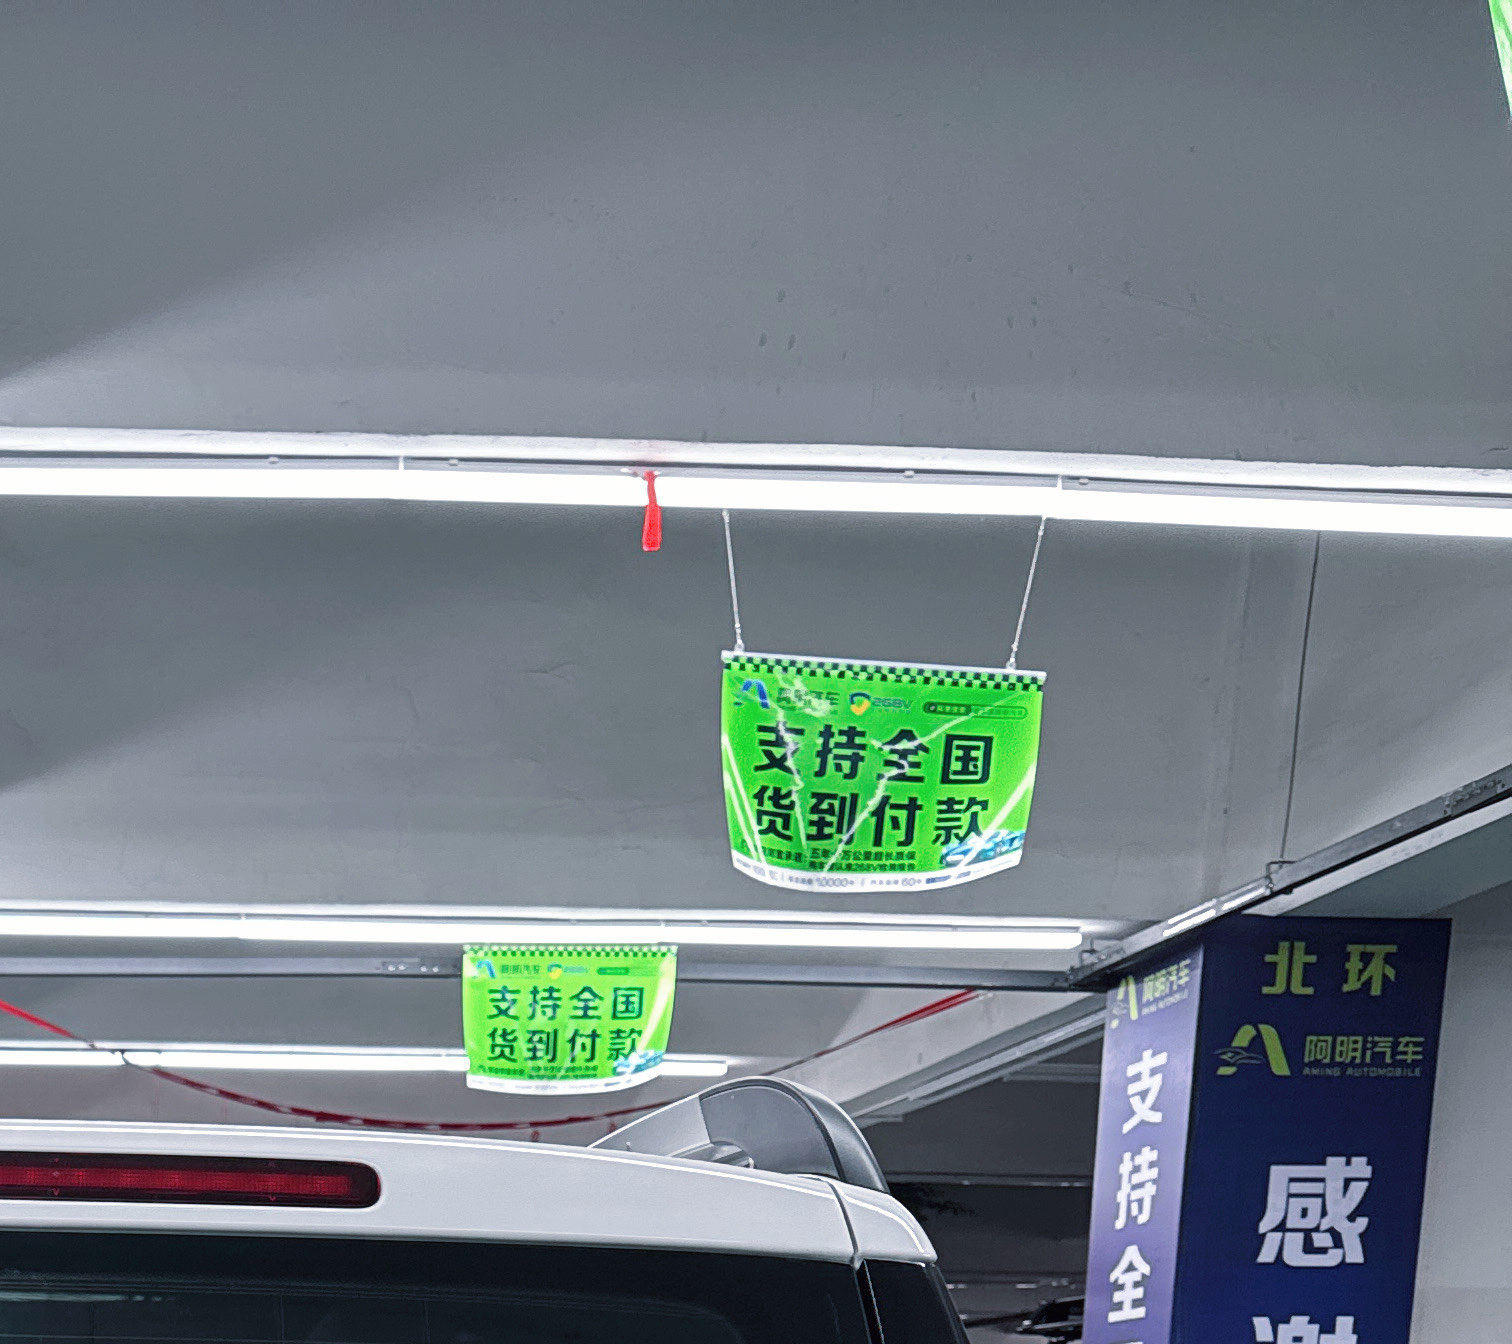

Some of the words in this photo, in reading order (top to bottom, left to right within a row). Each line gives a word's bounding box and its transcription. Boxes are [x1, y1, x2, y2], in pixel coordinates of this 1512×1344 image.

[753, 723, 994, 786] 支持全国
[752, 784, 990, 848] 货到付款
[1261, 940, 1398, 997] 北环
[486, 985, 644, 1021] 支持全国
[487, 1027, 642, 1064] 货到付款
[1304, 1035, 1425, 1063] 阿明汽车
